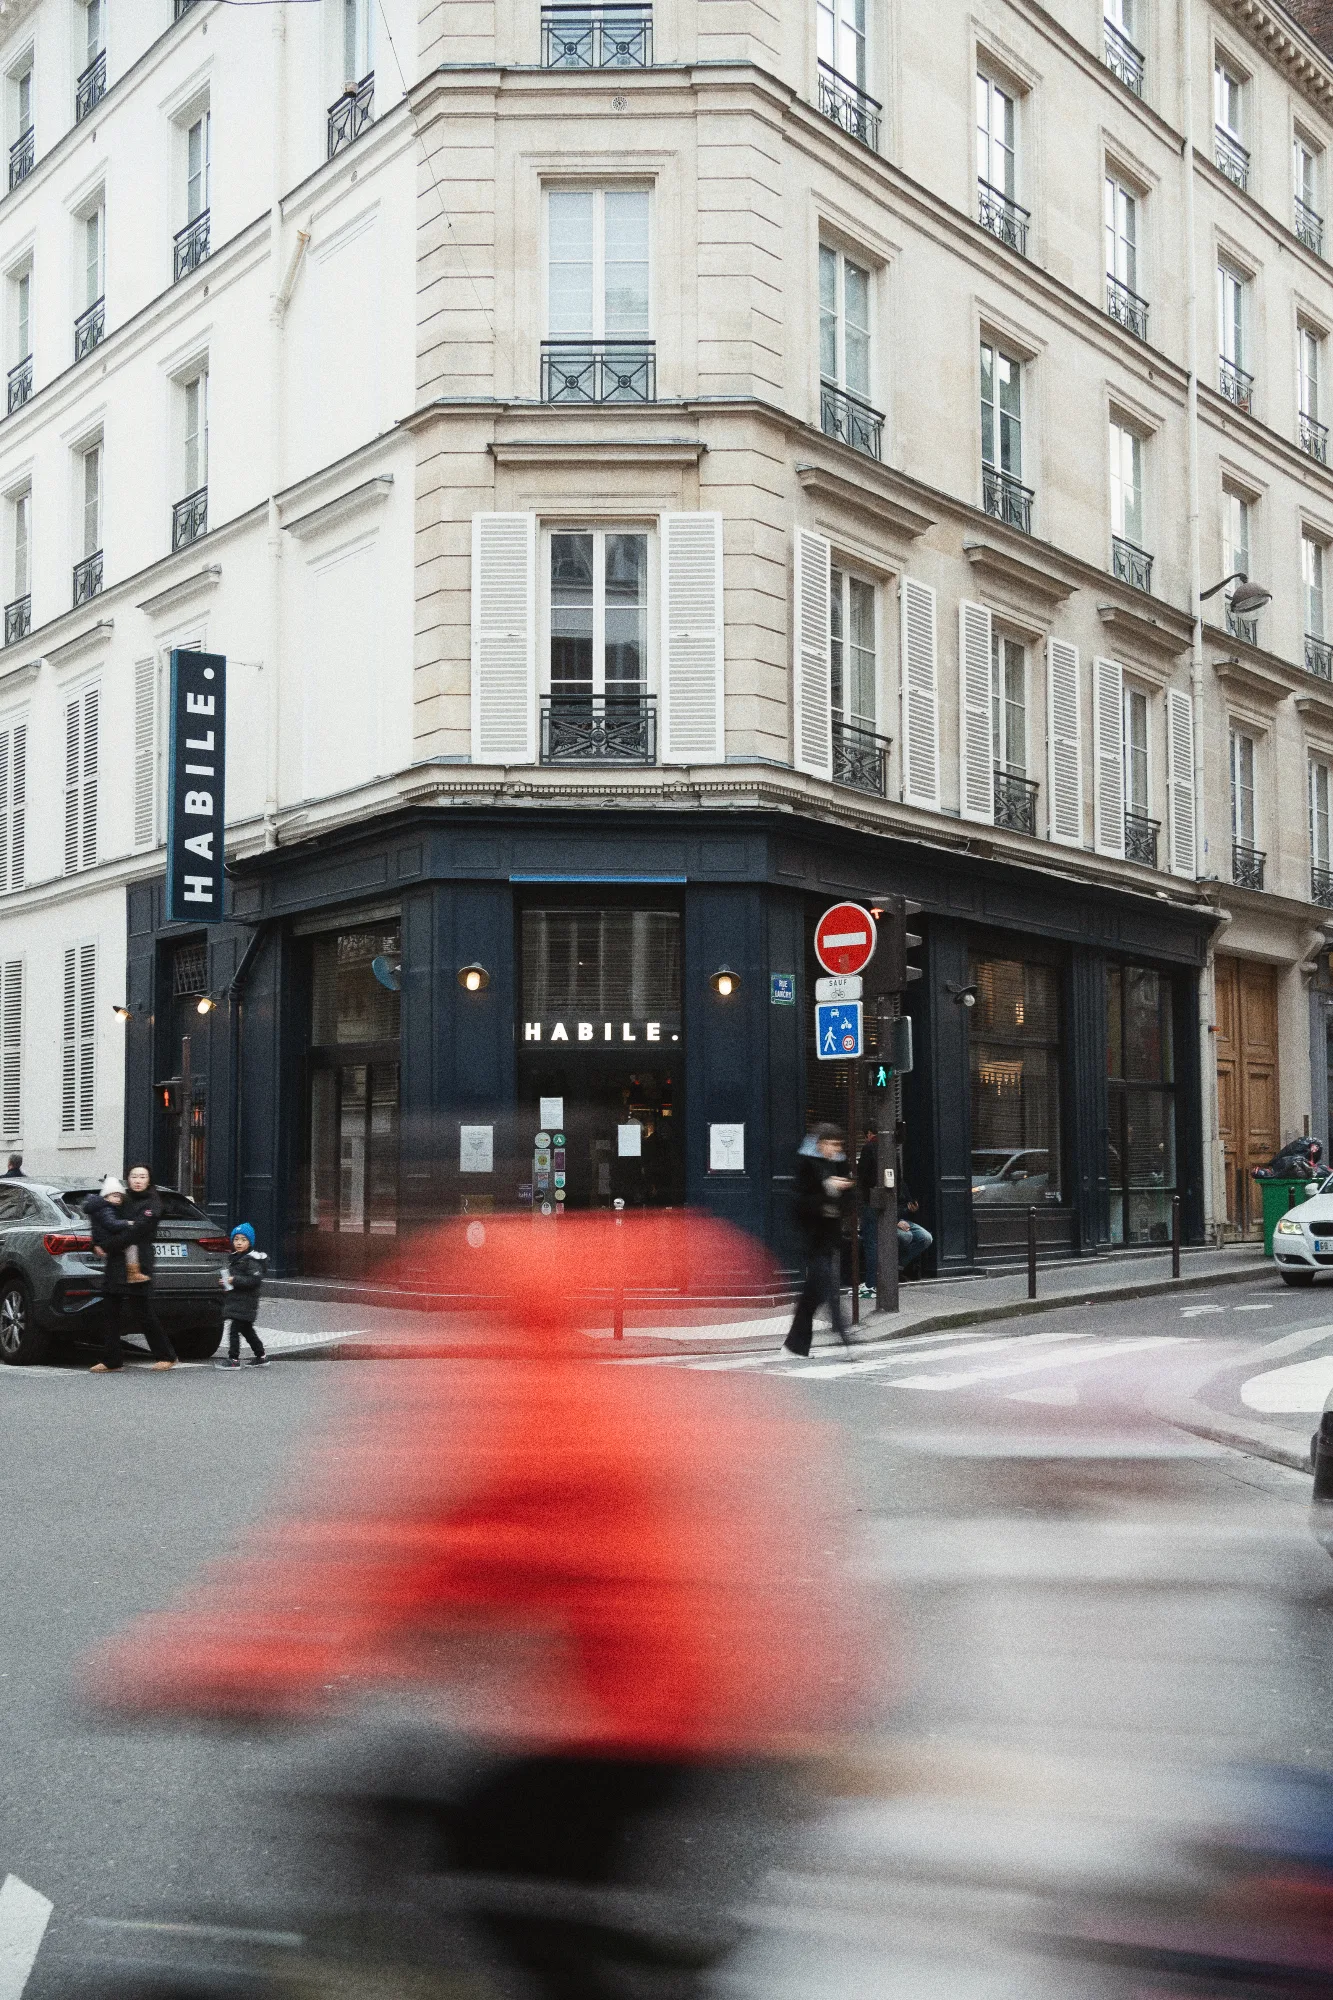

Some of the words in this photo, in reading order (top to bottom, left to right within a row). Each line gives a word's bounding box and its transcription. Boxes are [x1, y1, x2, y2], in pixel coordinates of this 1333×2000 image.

[183, 667, 215, 902] HABILE.
[778, 979, 788, 987] RUE
[524, 1022, 679, 1041] HABILE.
